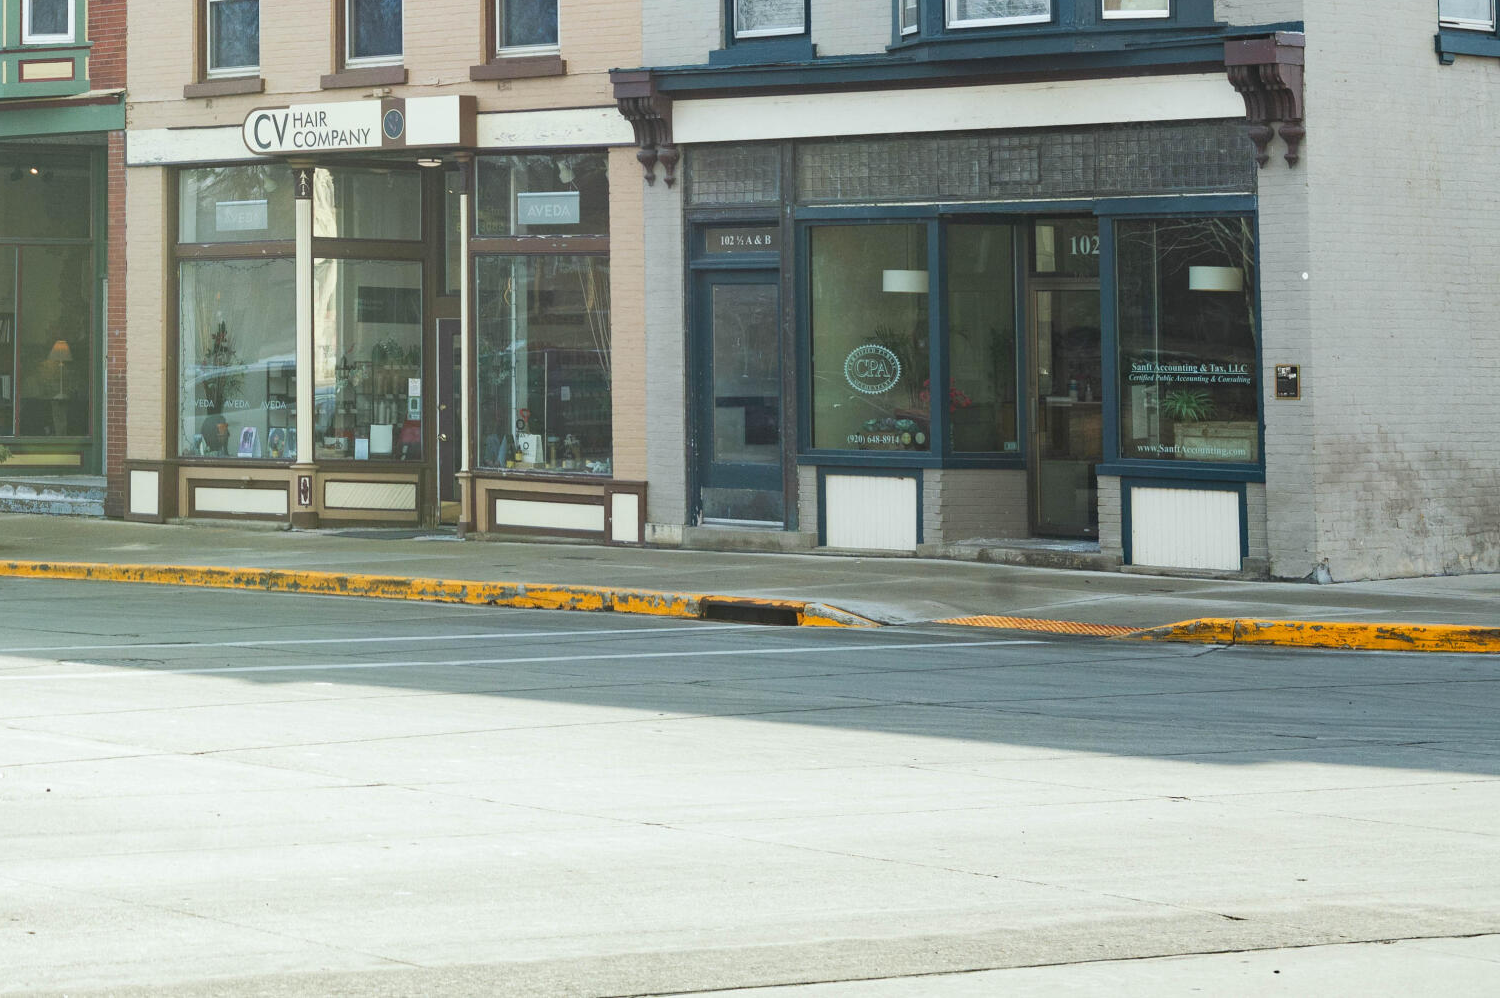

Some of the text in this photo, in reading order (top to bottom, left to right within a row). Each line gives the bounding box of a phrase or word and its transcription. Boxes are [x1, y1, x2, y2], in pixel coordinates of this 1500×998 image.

[293, 111, 328, 129] HAIR
[254, 113, 289, 149] CV
[293, 128, 371, 148] COMPANY
[527, 204, 571, 219] AVEDA
[721, 235, 734, 245] 102
[745, 235, 753, 245] A
[754, 234, 762, 245] &
[765, 234, 771, 245] B
[1069, 235, 1100, 255] 102
[855, 359, 891, 378] CPA
[1131, 362, 1152, 371] Sanft
[1154, 363, 1197, 373] Accounting
[1200, 363, 1207, 372] &
[1228, 363, 1248, 373] LLC
[1128, 373, 1251, 385] Certified Public Accounting & Consulting
[224, 399, 250, 409] AVEDA
[260, 400, 287, 410] AVEDA
[847, 434, 900, 444] (920) 648-8914
[1138, 443, 1246, 457] www.SanftAccounting.com
